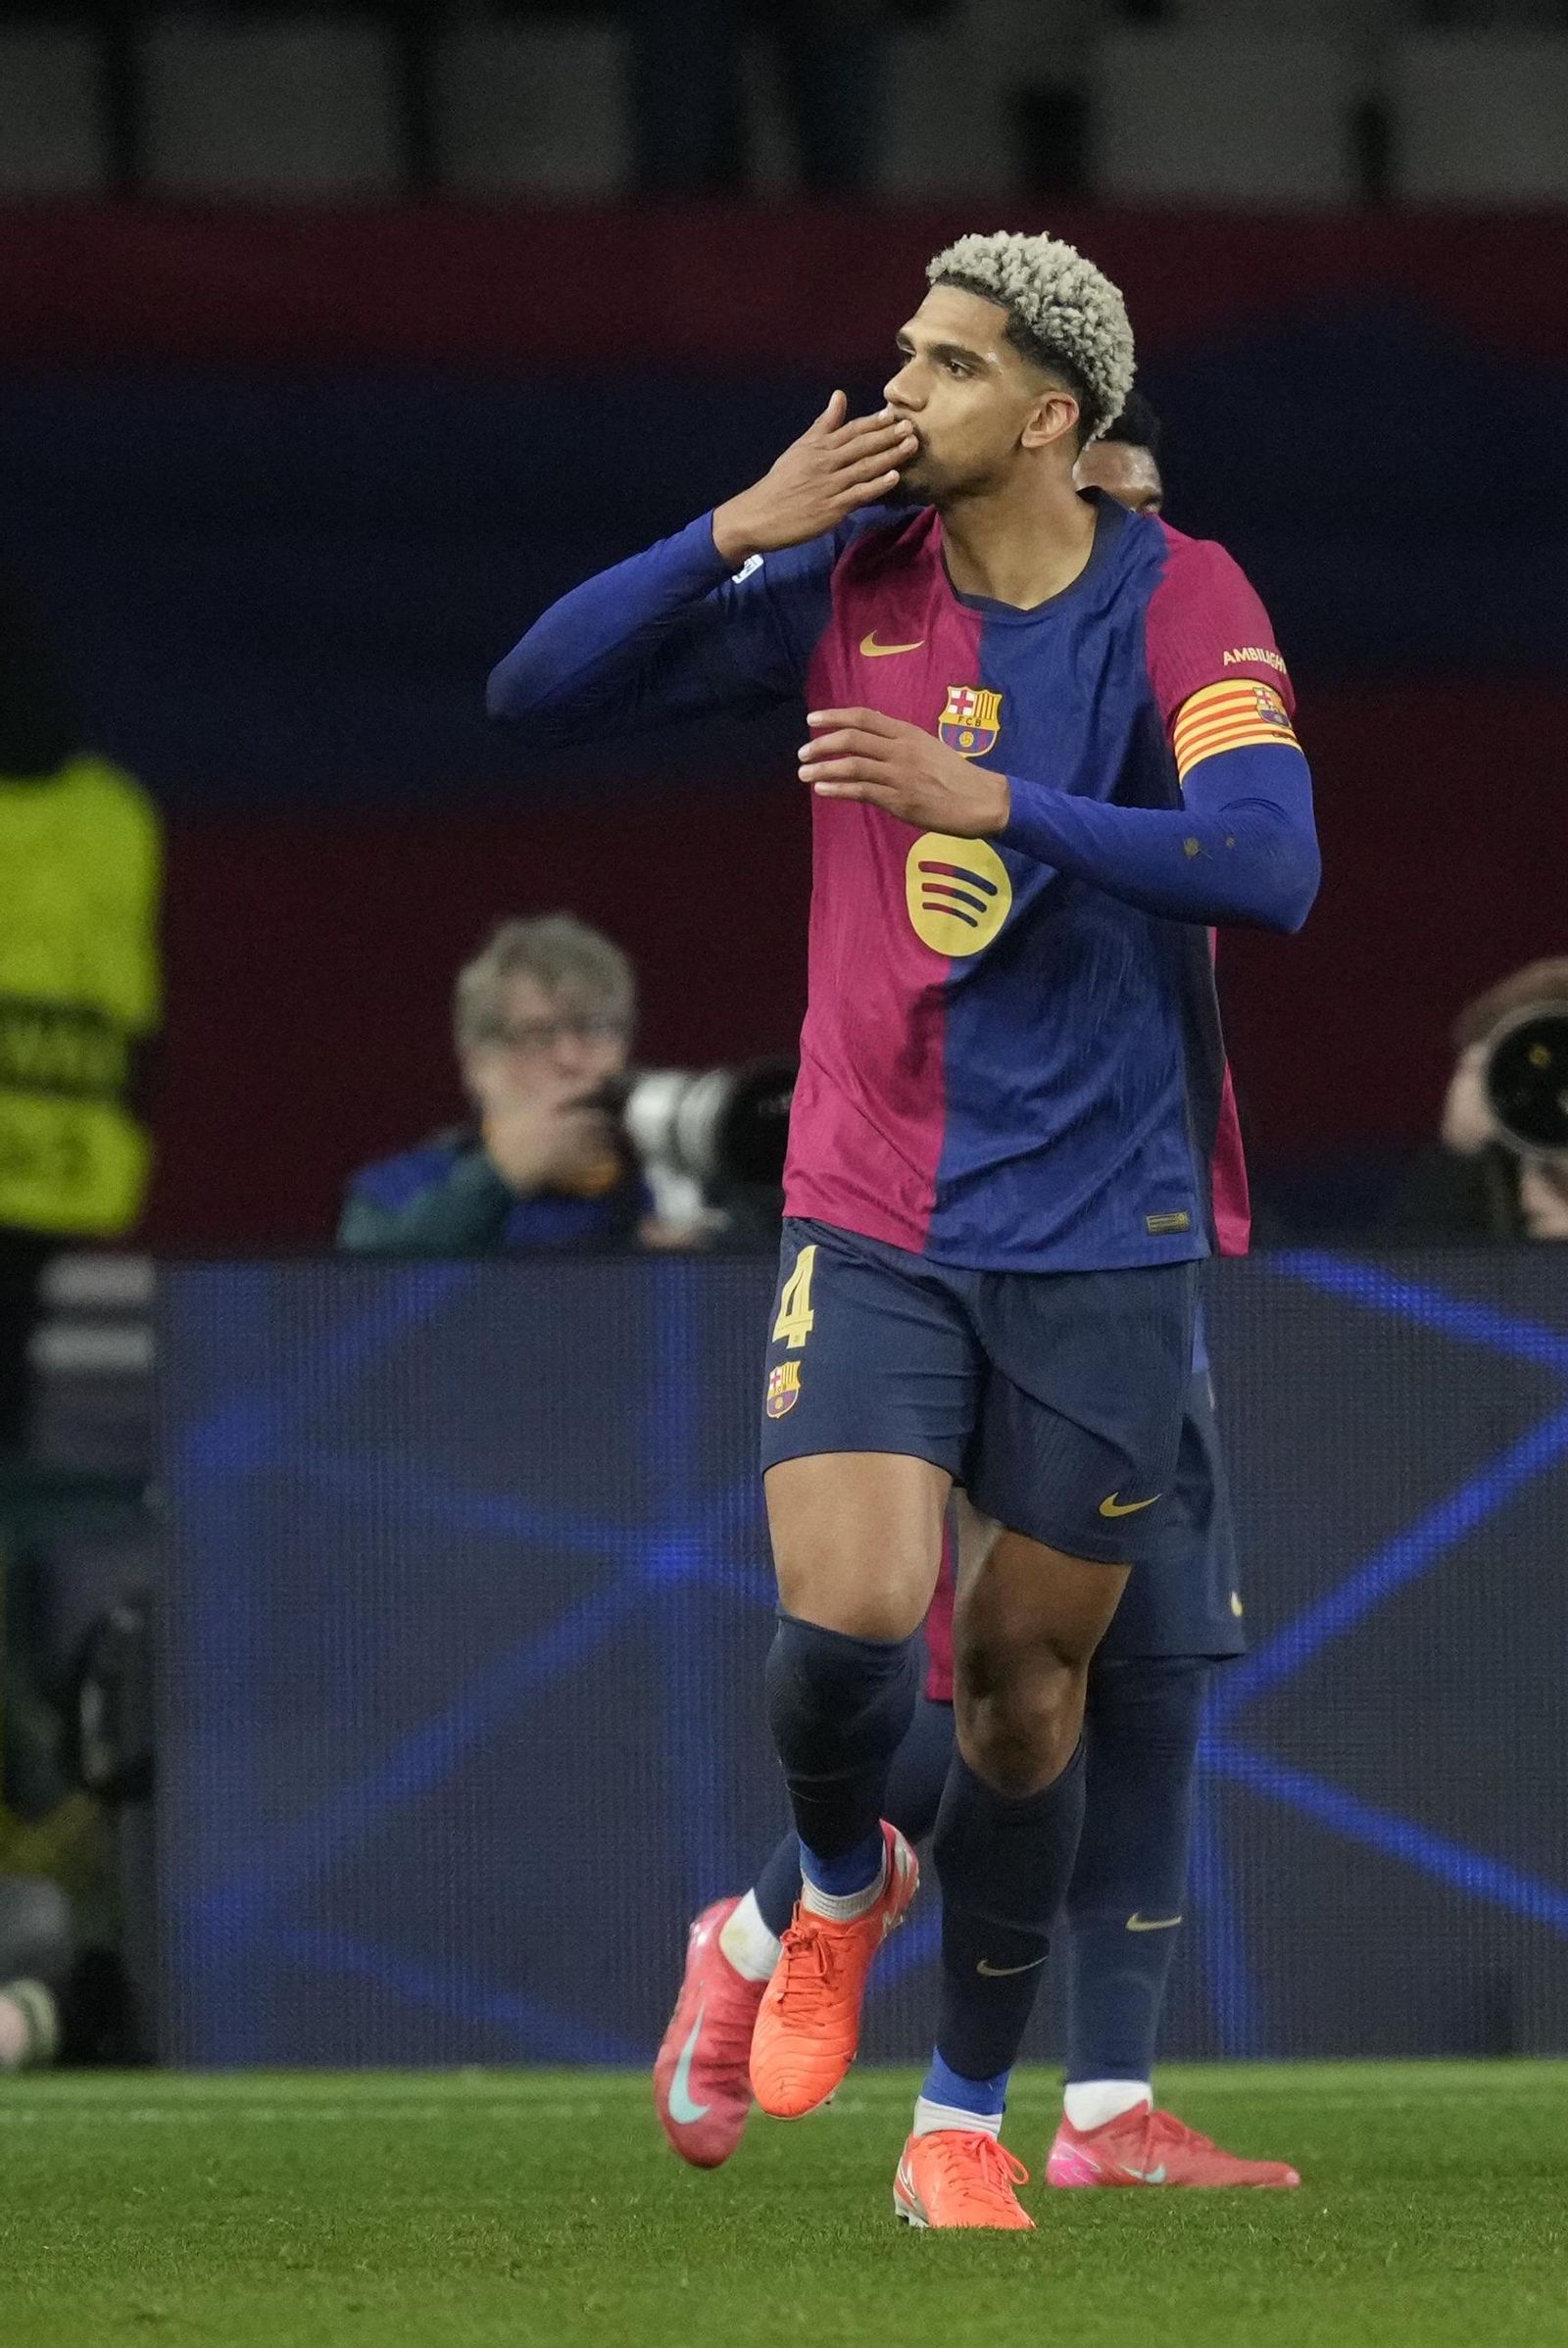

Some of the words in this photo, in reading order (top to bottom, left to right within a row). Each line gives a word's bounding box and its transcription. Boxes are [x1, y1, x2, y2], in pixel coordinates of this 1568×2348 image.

[1223, 647, 1287, 674] AMBILIGH
[957, 715, 982, 727] FCB
[772, 1245, 818, 1349] 4
